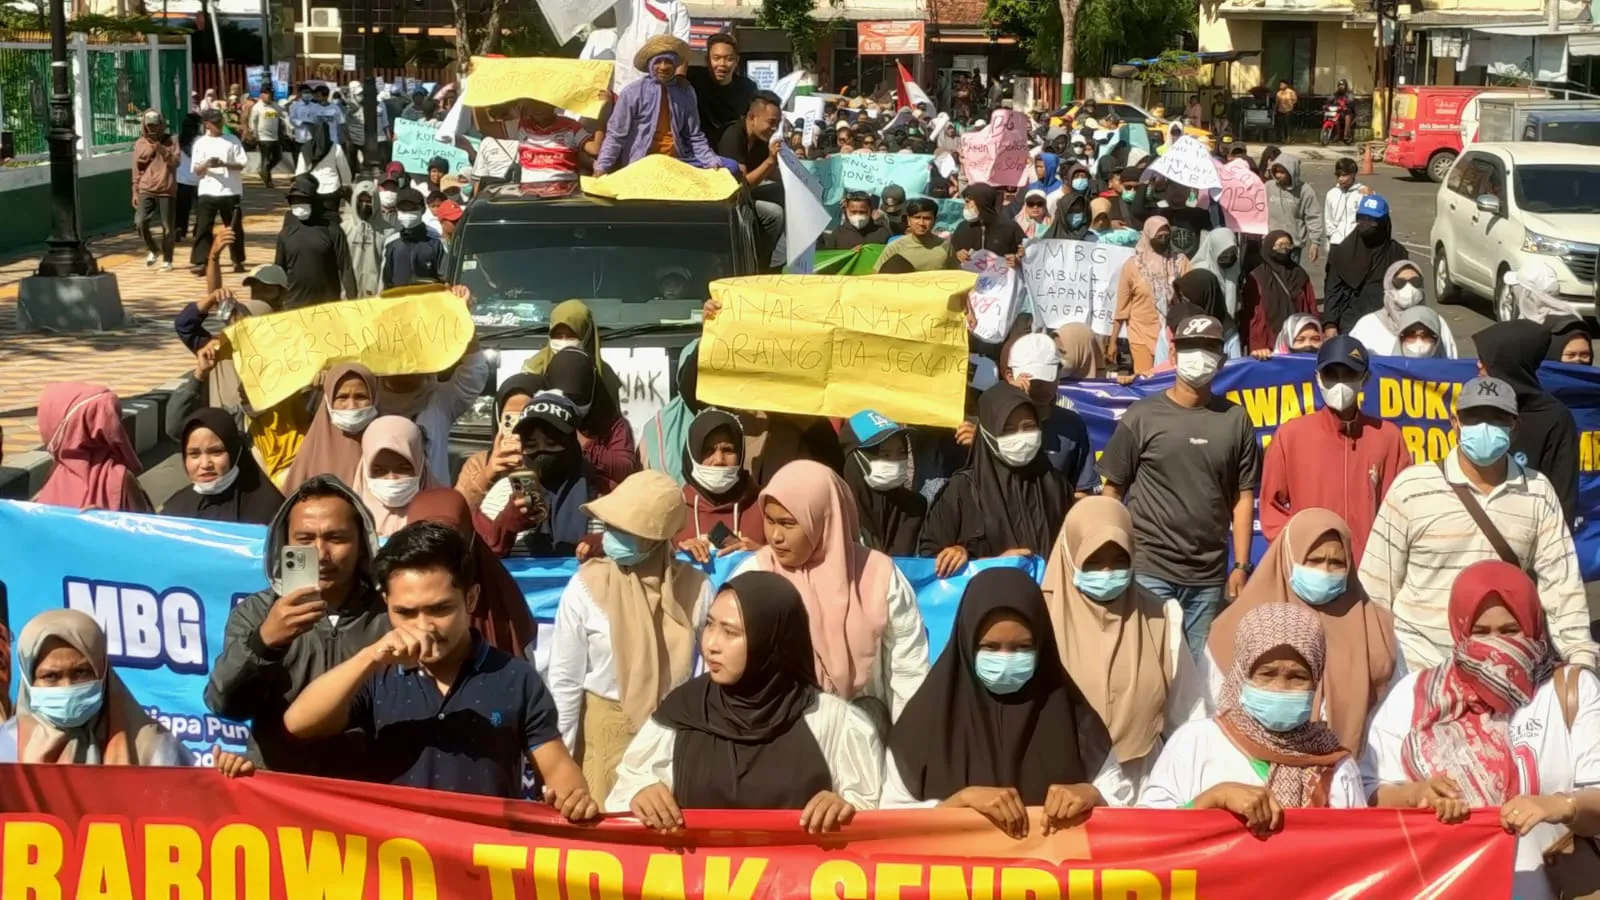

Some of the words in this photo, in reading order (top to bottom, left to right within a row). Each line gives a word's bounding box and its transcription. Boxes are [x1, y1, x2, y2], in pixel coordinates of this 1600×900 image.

[1042, 242, 1108, 264] MBG
[1024, 268, 1100, 285] MEMBUKA
[823, 299, 912, 338] ANAK
[248, 323, 405, 397] BERSAMA
[709, 332, 823, 371] ORANG
[68, 582, 204, 665] MBG
